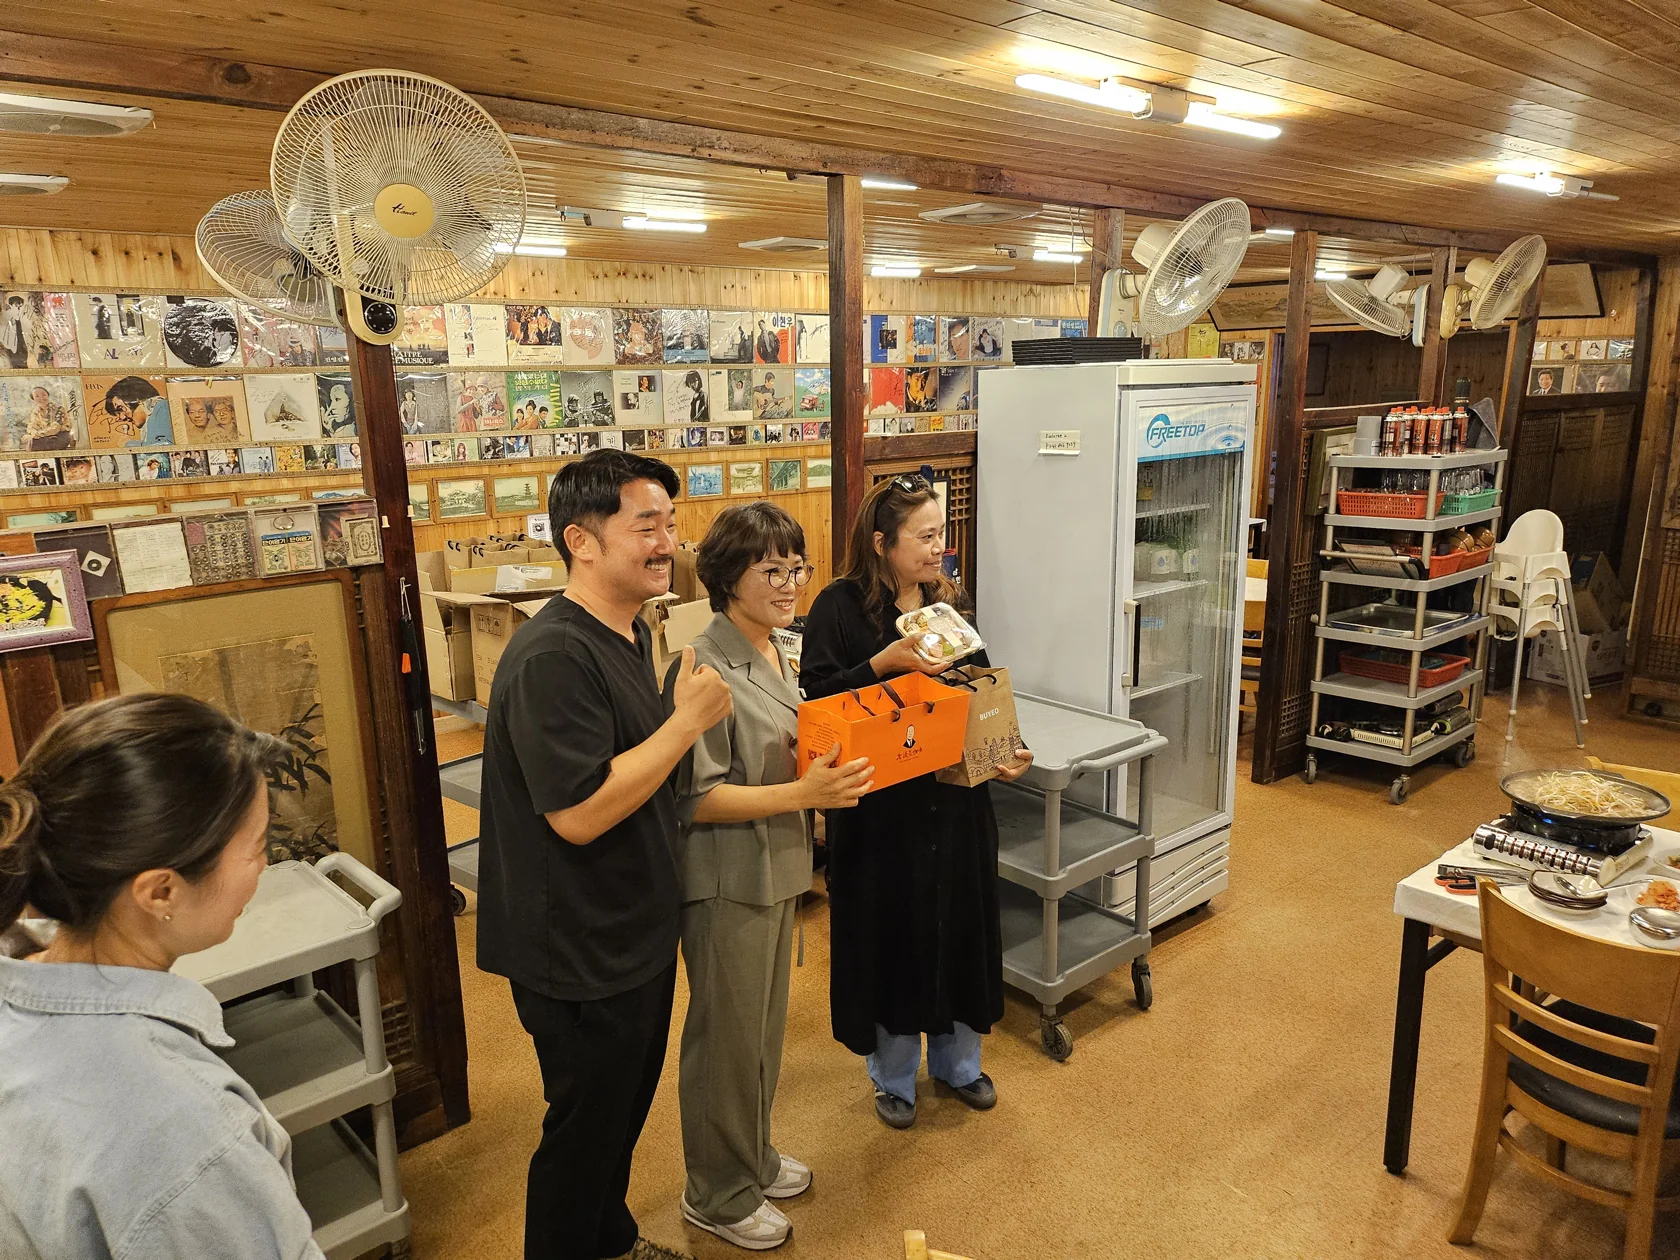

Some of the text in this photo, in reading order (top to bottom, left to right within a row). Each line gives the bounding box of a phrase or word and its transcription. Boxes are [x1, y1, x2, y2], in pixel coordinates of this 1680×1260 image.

[772, 316, 793, 328] 이현우
[1149, 423, 1206, 443] FREETOP
[979, 707, 1000, 721] BUYEO
